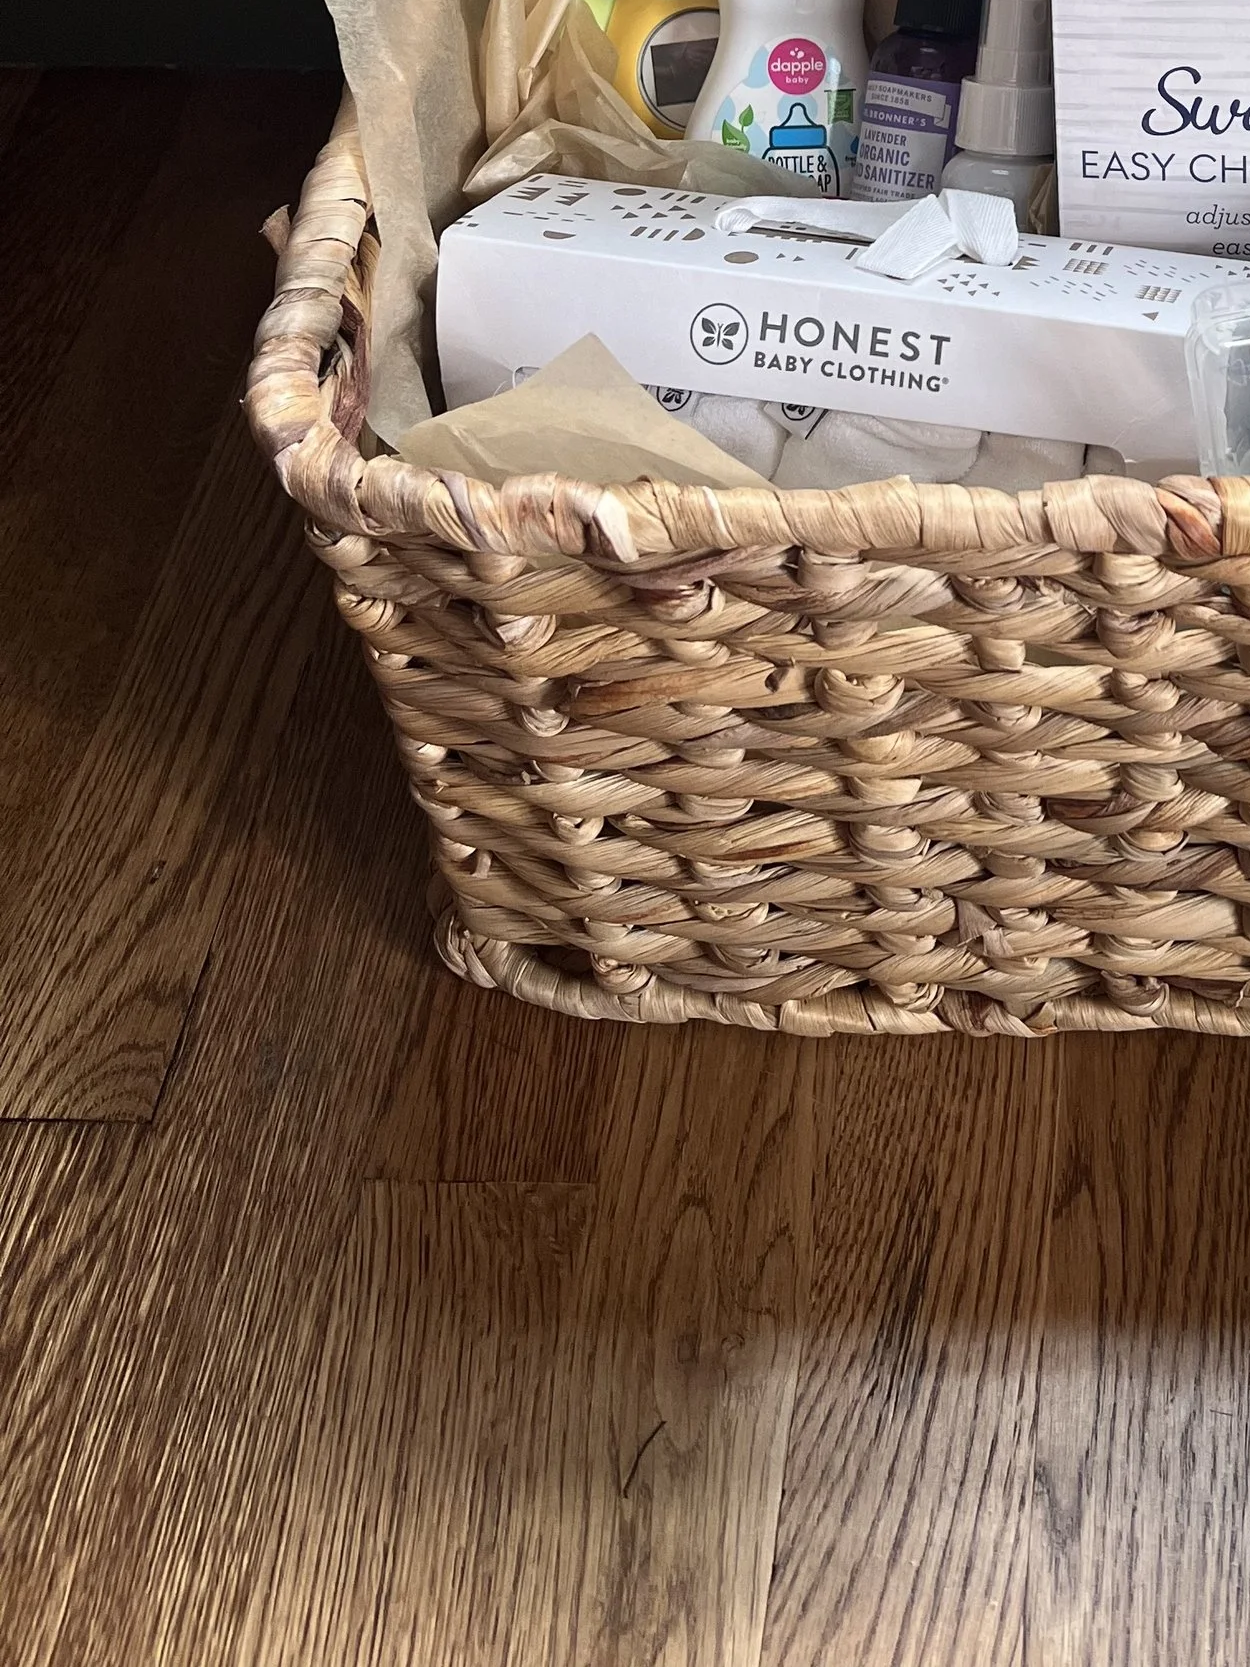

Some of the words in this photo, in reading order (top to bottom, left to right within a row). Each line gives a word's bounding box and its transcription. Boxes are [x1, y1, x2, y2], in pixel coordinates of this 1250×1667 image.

[770, 57, 824, 75] dapple
[785, 76, 810, 85] baby
[871, 92, 889, 102] SINCE
[890, 95, 910, 106] 1858
[879, 86, 933, 103] SOAPMAKERS
[864, 128, 907, 146] LAVENDER
[817, 154, 828, 173] &
[859, 143, 910, 167] ORGANIC
[1081, 150, 1176, 183] EASY
[864, 165, 935, 191] SANITIZER
[759, 310, 951, 366] HONEST
[753, 350, 813, 374] BABY
